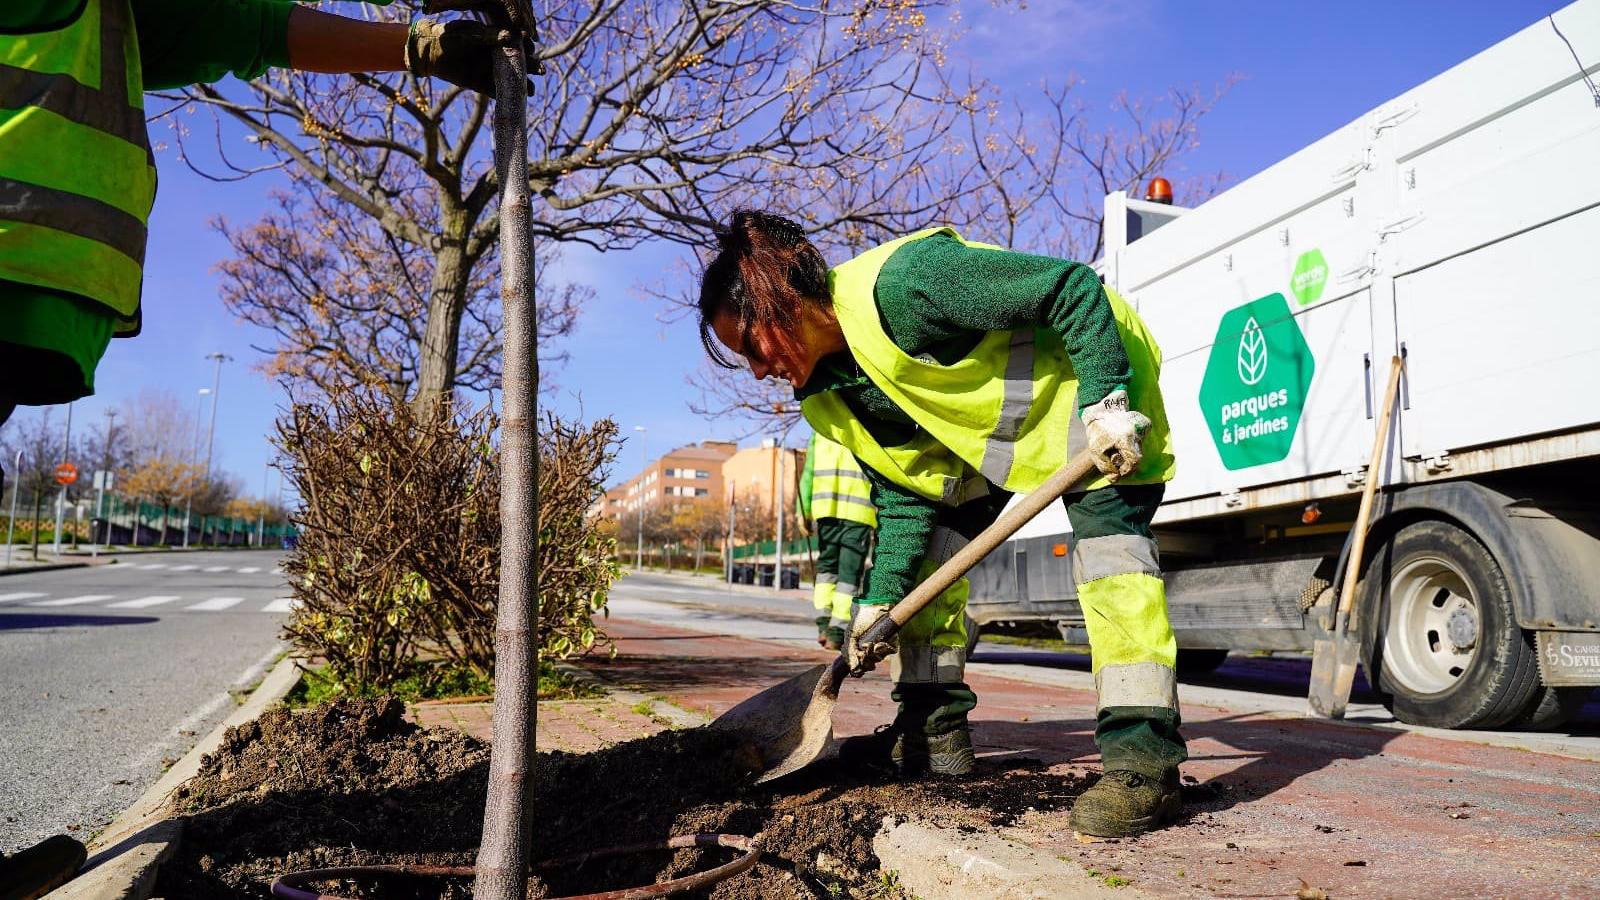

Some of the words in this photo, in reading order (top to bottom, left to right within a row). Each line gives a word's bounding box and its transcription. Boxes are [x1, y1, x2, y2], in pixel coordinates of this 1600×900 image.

[1222, 389, 1287, 425] parques
[1222, 428, 1232, 444] &
[1234, 416, 1288, 445] jardines
